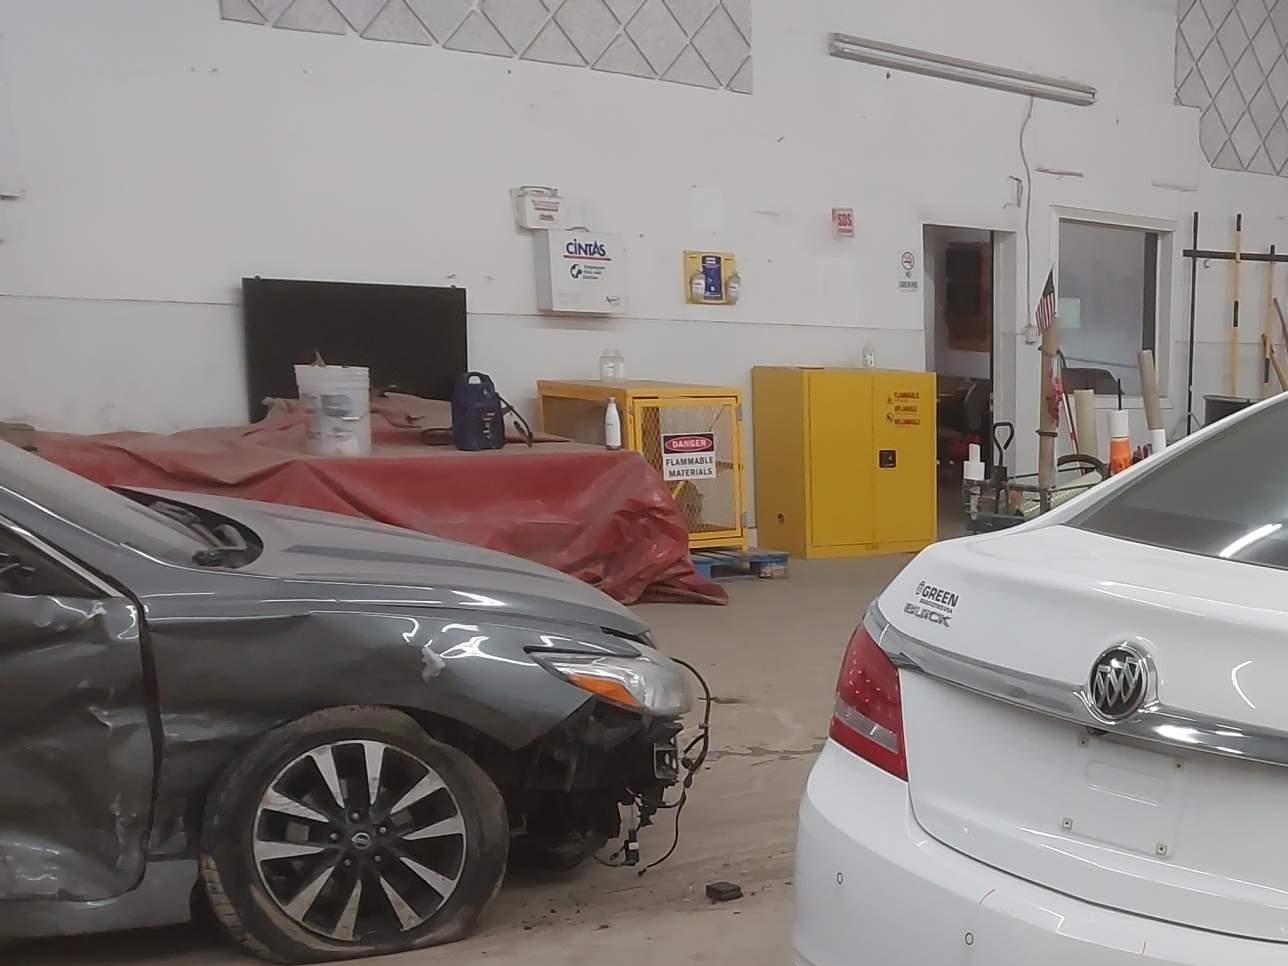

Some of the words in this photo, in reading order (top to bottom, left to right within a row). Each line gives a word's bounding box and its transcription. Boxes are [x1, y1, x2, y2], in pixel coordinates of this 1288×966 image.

[837, 213, 852, 227] SDS
[672, 439, 706, 448] DANGER
[665, 456, 714, 466] FLAMMABLE
[669, 468, 713, 477] MATERIALS
[922, 585, 960, 607] GREEN
